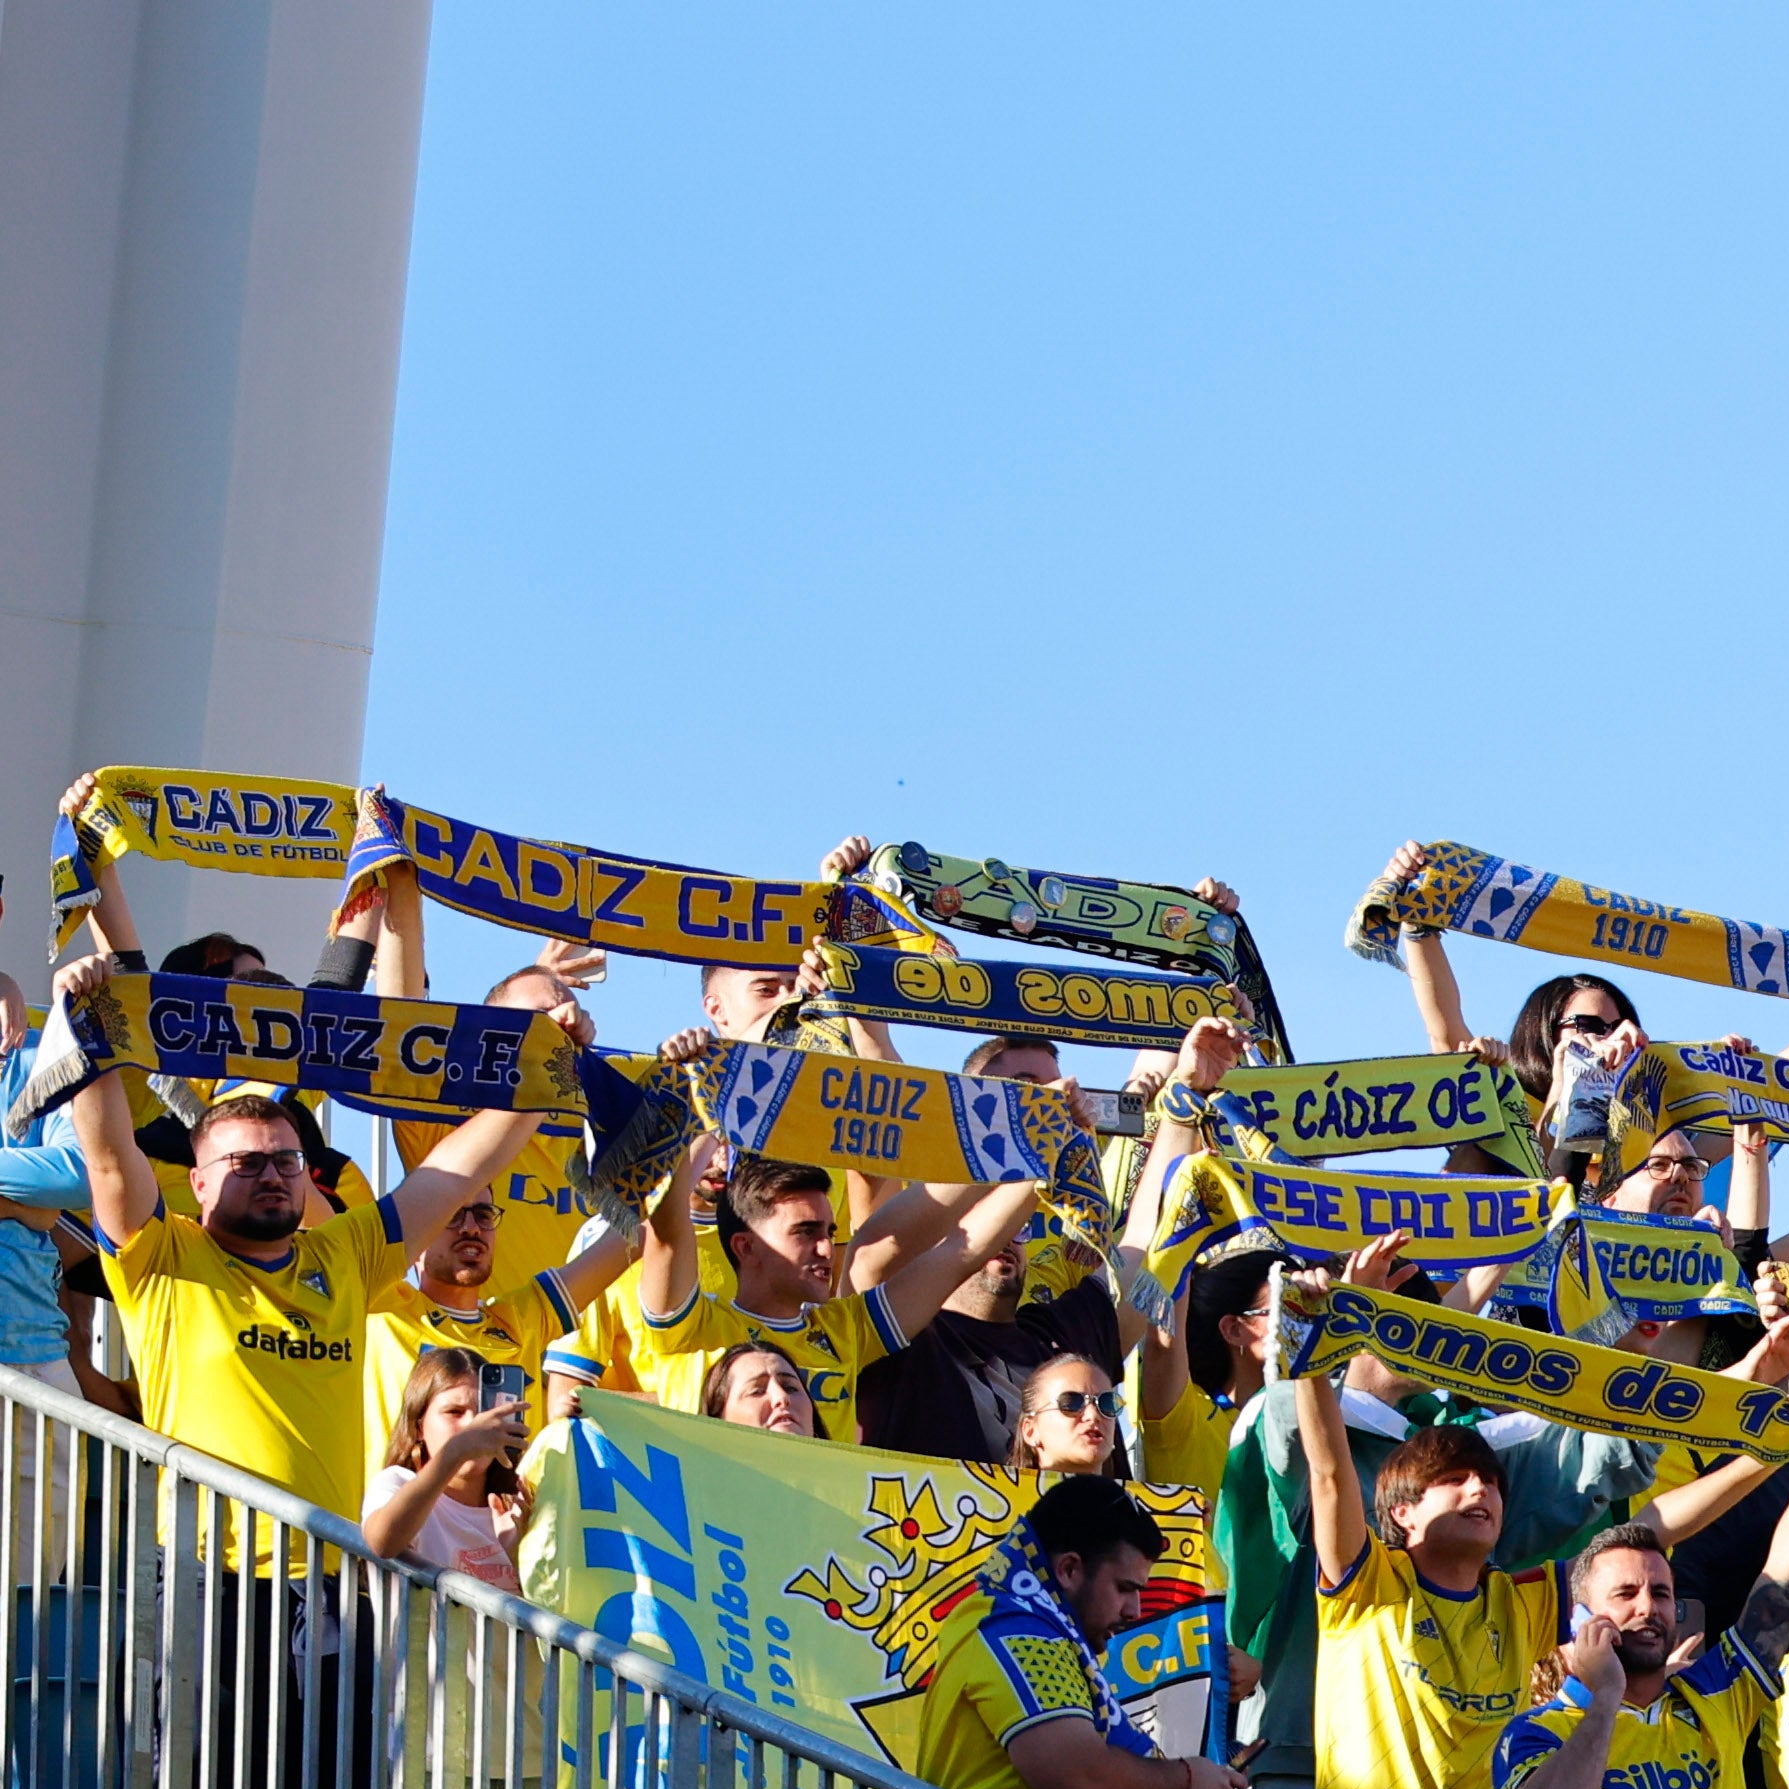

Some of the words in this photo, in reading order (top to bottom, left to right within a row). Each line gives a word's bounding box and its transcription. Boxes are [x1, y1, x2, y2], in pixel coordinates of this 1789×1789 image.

[163, 784, 338, 841] CÁDIZ
[169, 835, 228, 854] CLUB
[233, 842, 265, 858] DE
[403, 810, 646, 928] CADIZ
[1590, 913, 1669, 960] 1910
[148, 997, 386, 1072] CADIZ
[820, 1065, 930, 1121] CÁDIZ
[1679, 1046, 1767, 1087] Cádiz
[1292, 1071, 1416, 1140] CÁDIZ
[1726, 1086, 1760, 1118] No
[831, 1117, 903, 1160] 1910
[238, 1324, 353, 1362] dafabet
[1325, 1286, 1581, 1396] Somos
[1602, 1358, 1706, 1423] de
[704, 1523, 756, 1703] Fútbol
[766, 1616, 797, 1708] 1910
